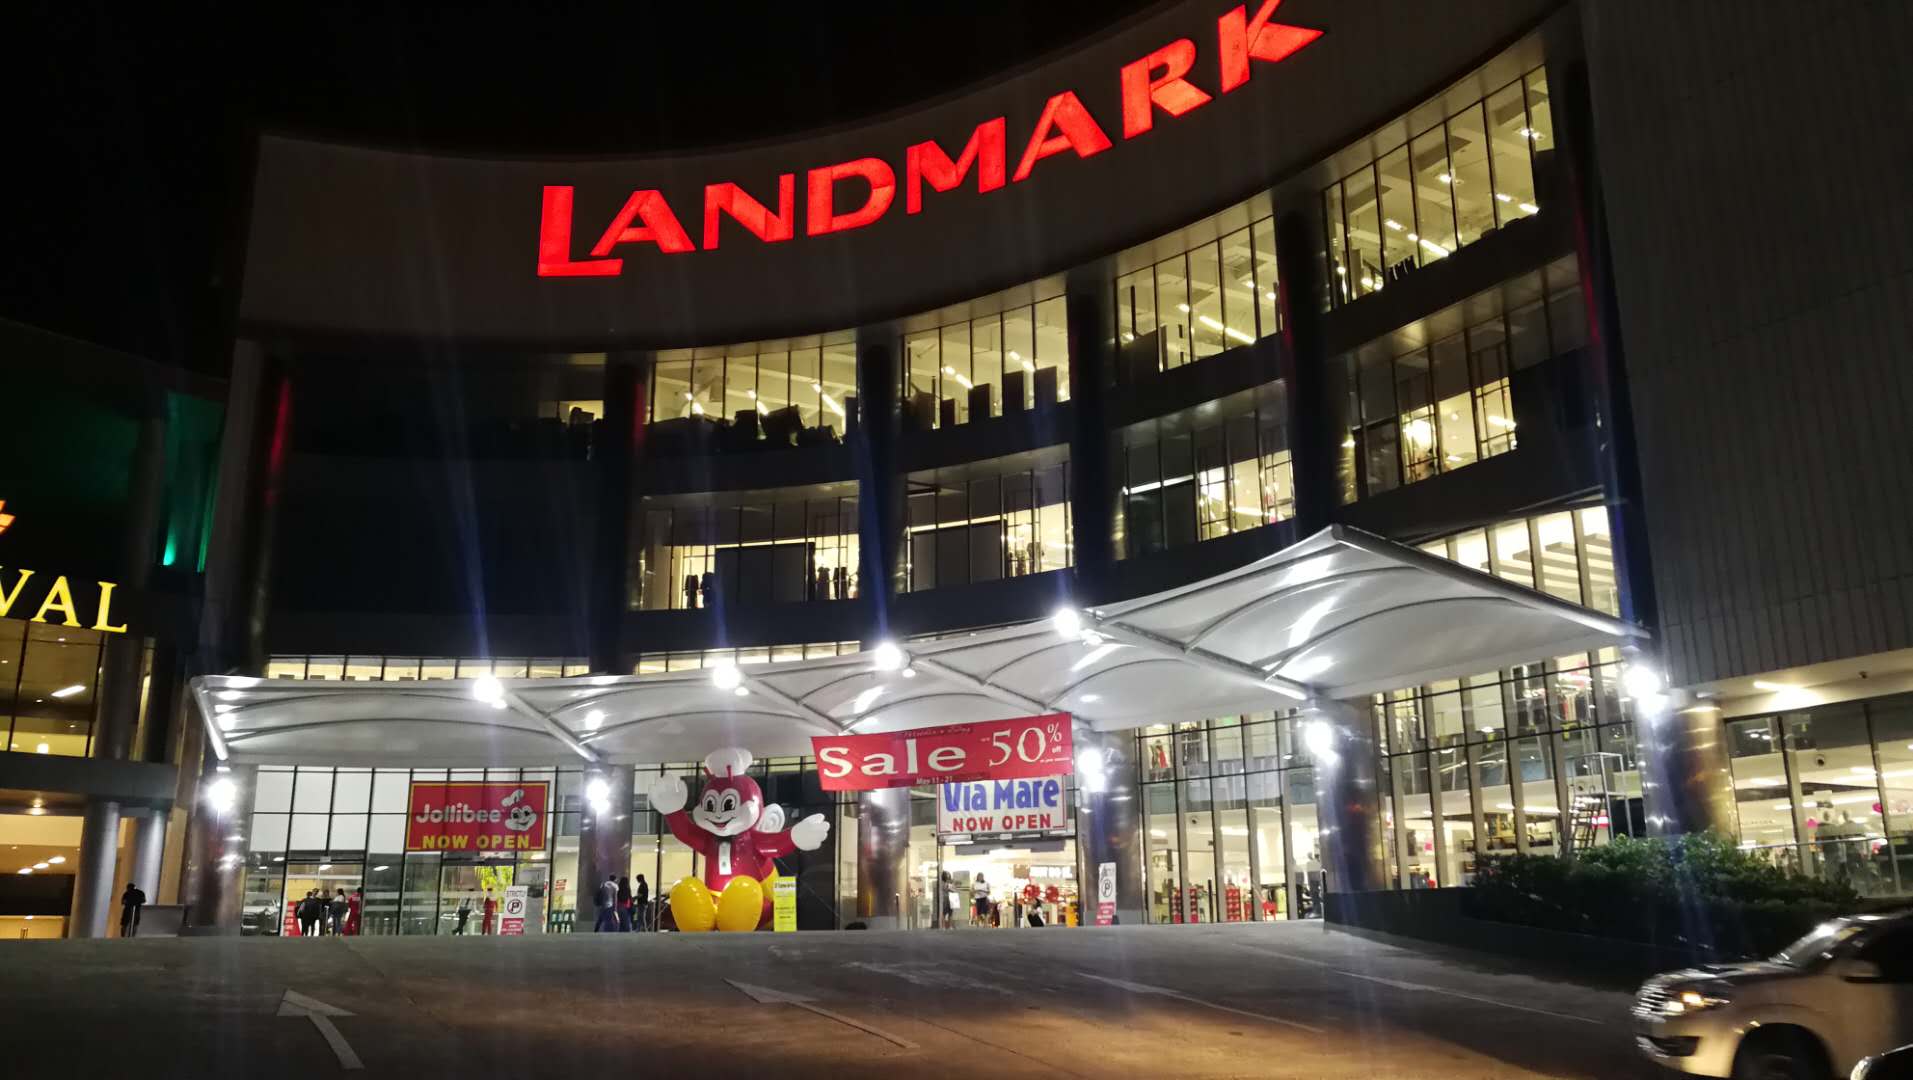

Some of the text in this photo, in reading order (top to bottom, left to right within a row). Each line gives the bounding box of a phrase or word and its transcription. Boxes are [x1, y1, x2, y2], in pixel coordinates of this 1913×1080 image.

[537, 0, 1325, 278] LANDMARK
[819, 738, 966, 778] Sale
[943, 779, 1059, 812] Via Mare
[416, 803, 500, 824] Jollibee
[953, 813, 1051, 832] NOW OPEN
[422, 834, 530, 849] NOW OPEN
